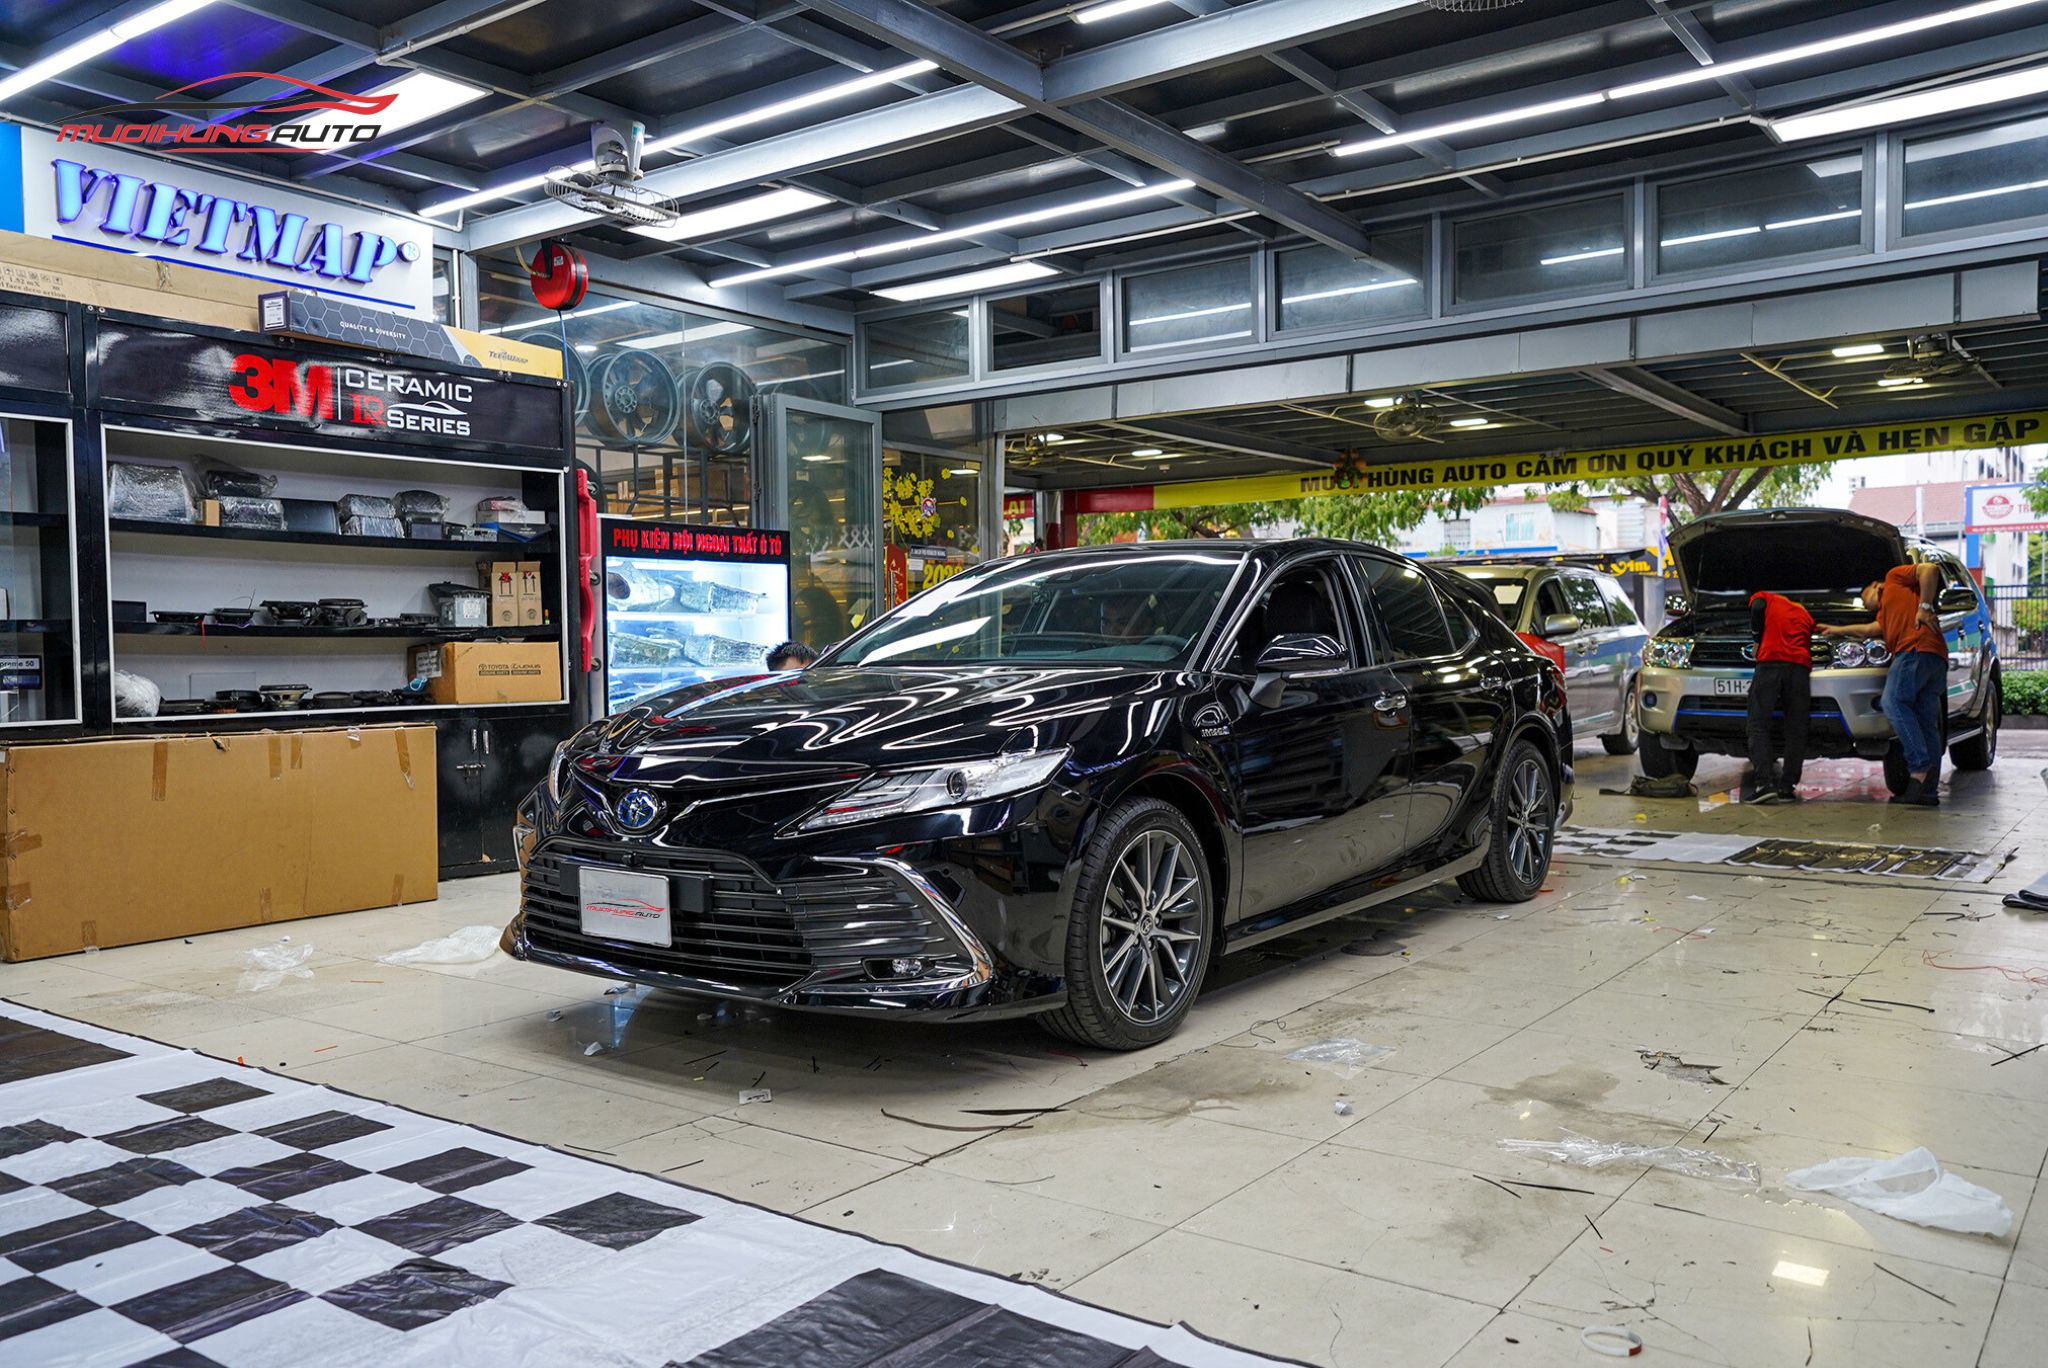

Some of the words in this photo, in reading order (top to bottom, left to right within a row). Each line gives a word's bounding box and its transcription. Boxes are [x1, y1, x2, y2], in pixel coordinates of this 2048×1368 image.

[339, 321, 367, 332] QUALITY
[375, 328, 407, 340] DIVERSITY
[228, 353, 334, 420] 3M
[345, 369, 473, 402] CERAMIC
[386, 408, 471, 437] SERIES
[1367, 467, 1434, 488] HÙNG
[1442, 463, 1506, 483] AUTO
[1515, 453, 1577, 477] CẢM
[1588, 453, 1627, 473] ƠN
[1637, 445, 1693, 470] QUÝ
[1705, 438, 1812, 464] KHÁCH
[1823, 430, 1867, 455] VÀ
[1878, 426, 1949, 453] HẸN
[1963, 417, 2040, 447] GẶP
[613, 527, 638, 552] PHỤ
[641, 527, 669, 553] KIỆN
[672, 528, 693, 555] NỘI
[695, 533, 729, 557] NGOẠI
[732, 530, 758, 554] THẤT
